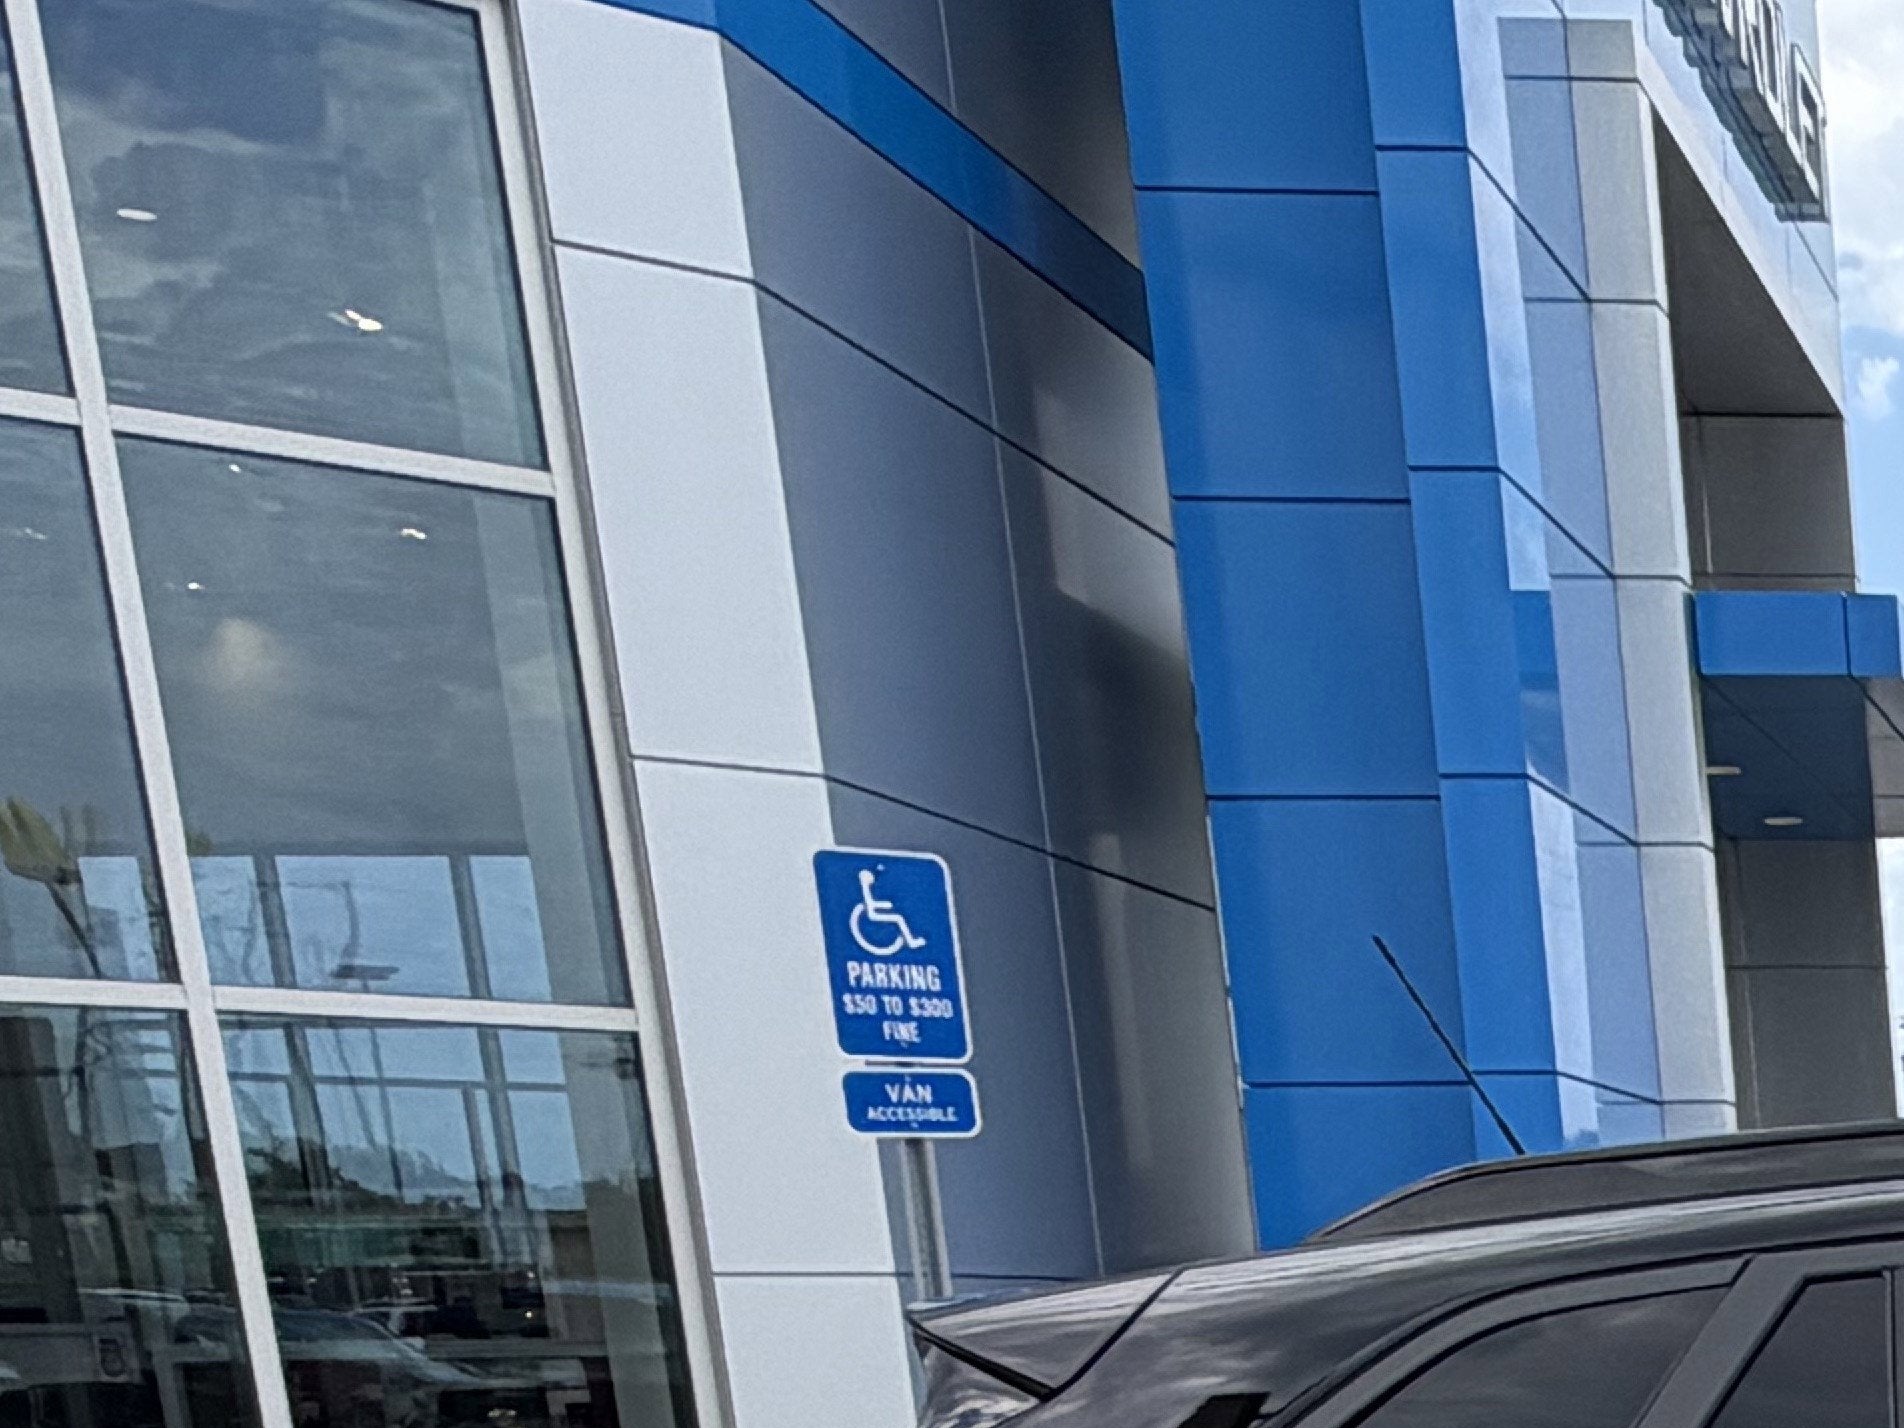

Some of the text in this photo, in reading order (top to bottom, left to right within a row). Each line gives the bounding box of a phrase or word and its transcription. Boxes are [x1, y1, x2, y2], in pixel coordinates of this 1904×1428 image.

[846, 961, 942, 992] PARKING
[843, 993, 878, 1016] $50
[882, 994, 903, 1016] TO
[882, 1020, 920, 1043] FINE
[884, 1083, 932, 1104] VAN
